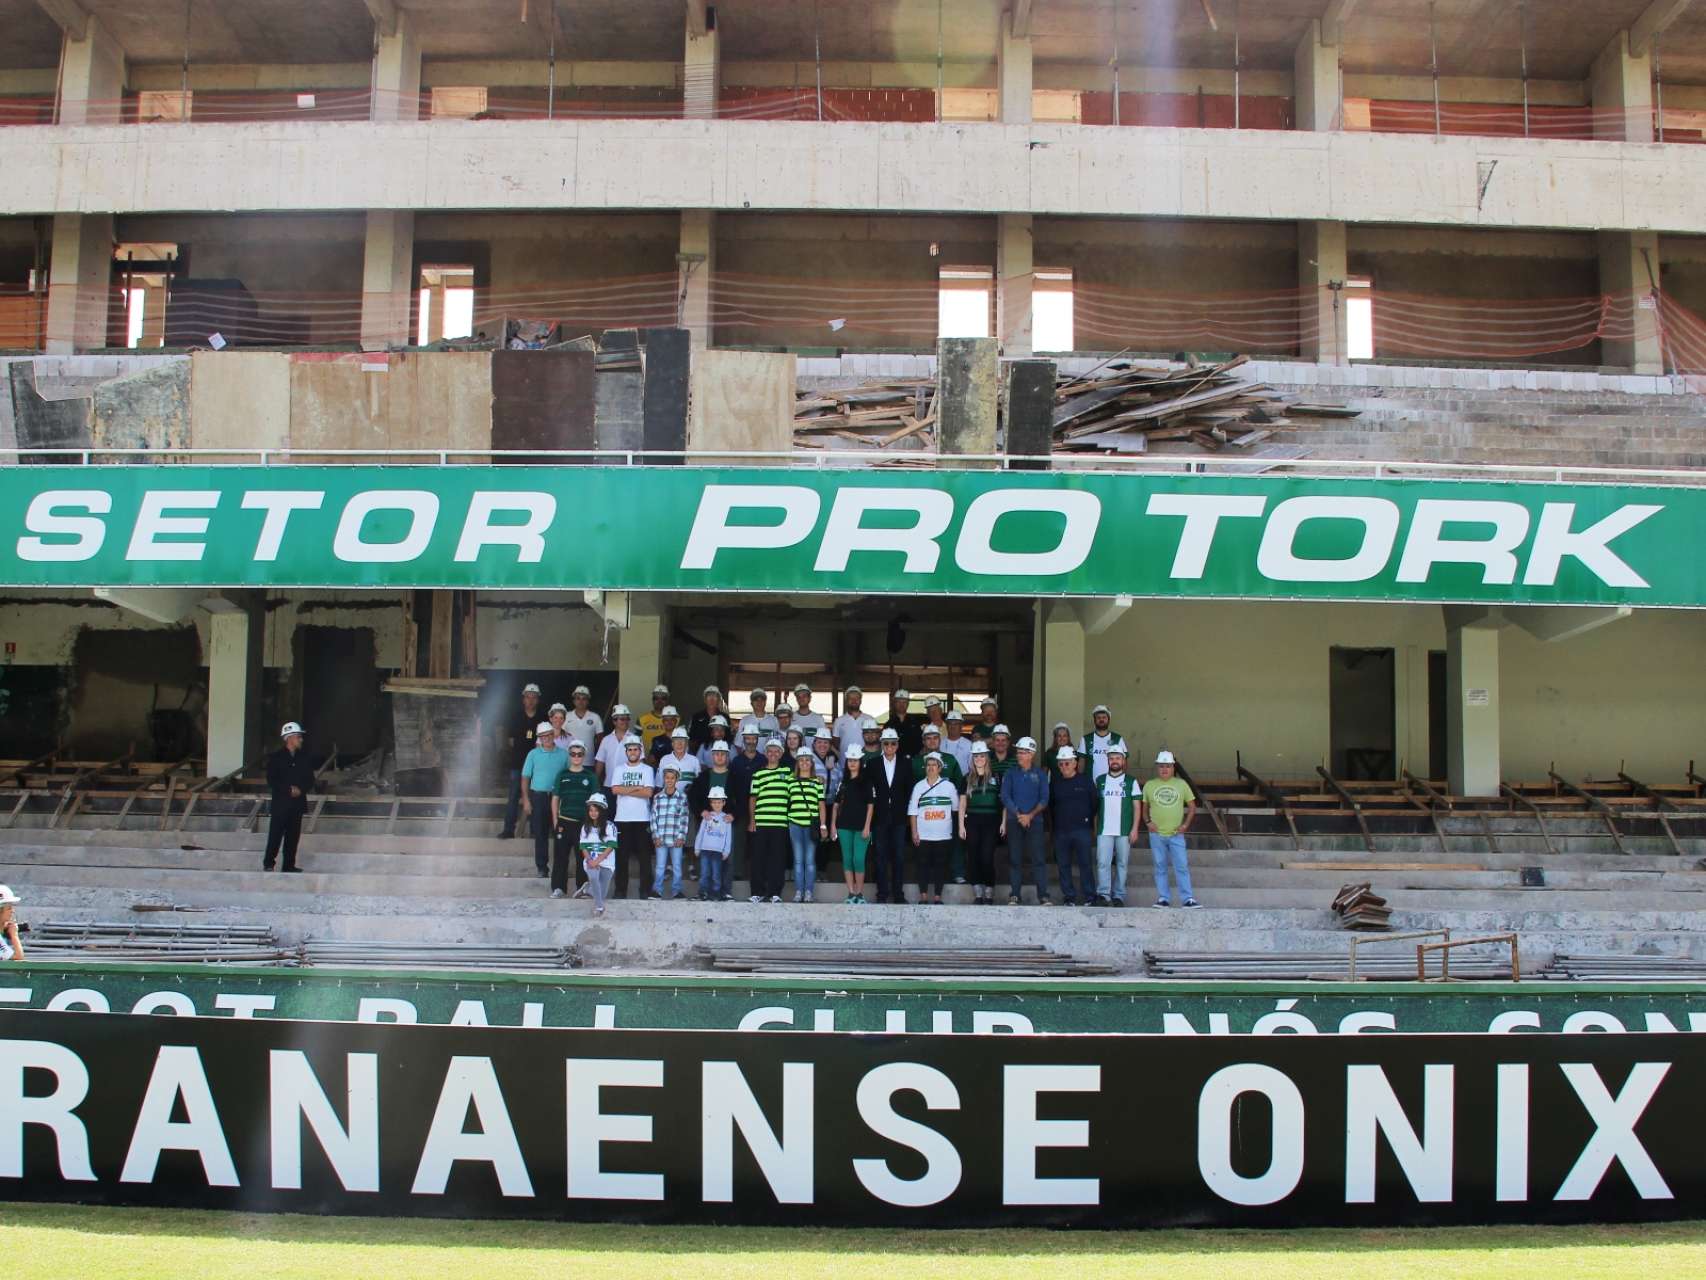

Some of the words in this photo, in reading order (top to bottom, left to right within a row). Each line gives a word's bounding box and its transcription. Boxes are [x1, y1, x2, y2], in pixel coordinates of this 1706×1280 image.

[16, 490, 557, 563] SETOR
[681, 484, 1102, 576] PRO
[1146, 493, 1665, 588] TORK
[622, 772, 643, 781] GREEN
[0, 1039, 1101, 1207] RANAENSE
[1198, 1062, 1674, 1206] ONIX
